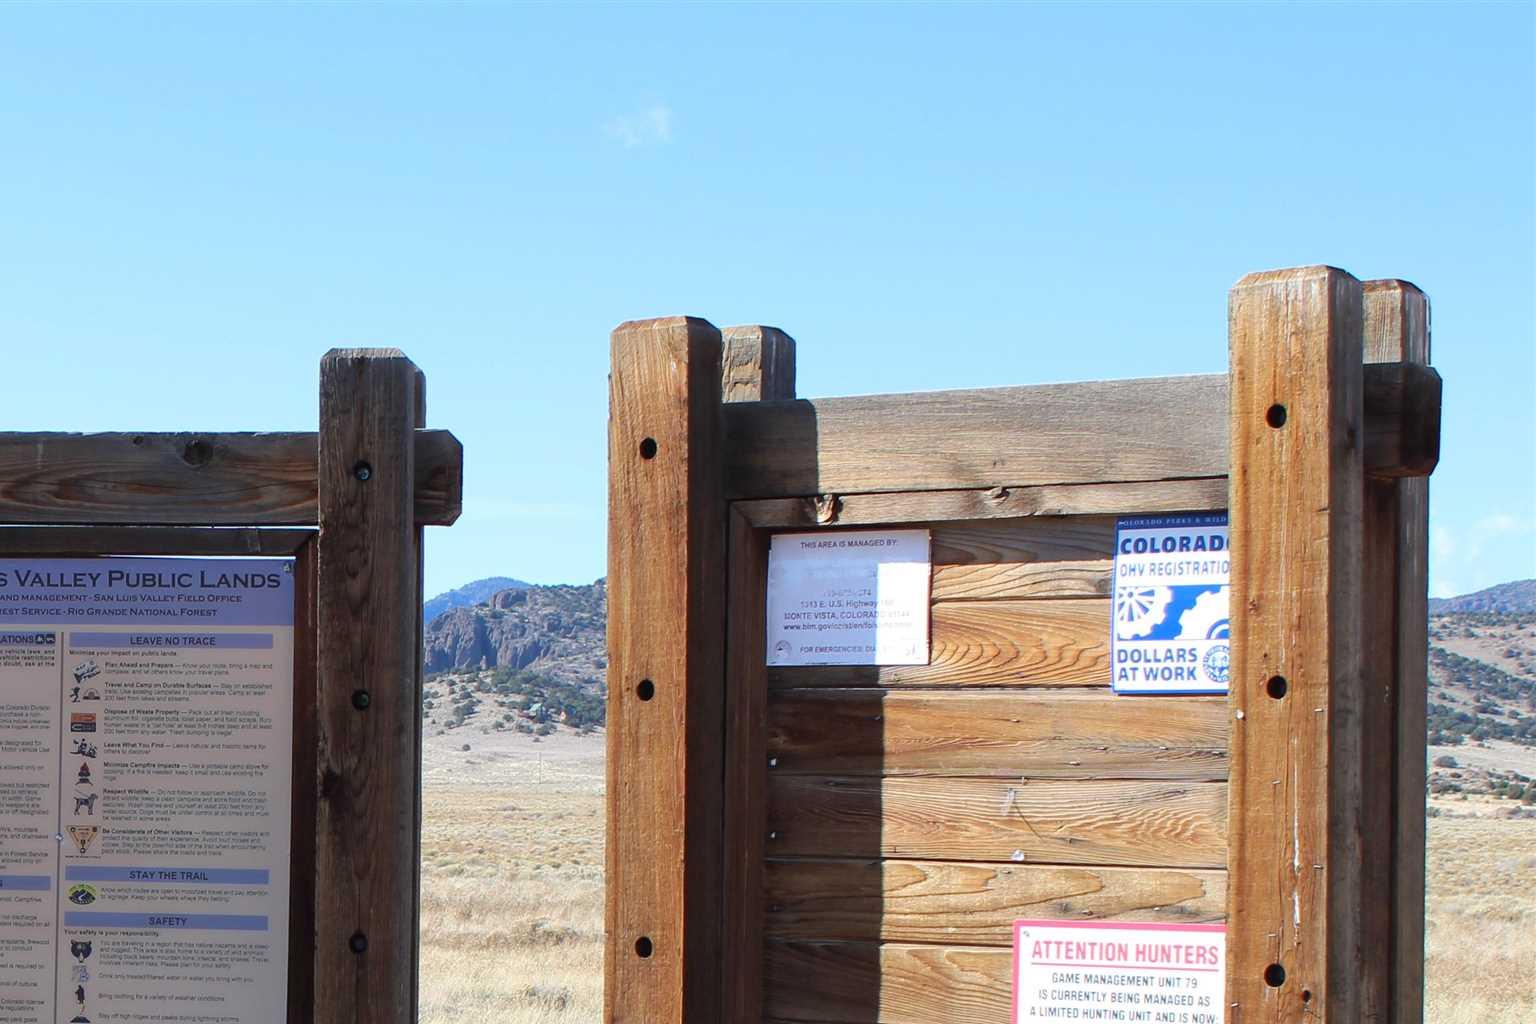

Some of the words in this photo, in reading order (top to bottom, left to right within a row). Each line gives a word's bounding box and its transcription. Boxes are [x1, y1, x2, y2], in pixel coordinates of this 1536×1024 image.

[800, 541, 816, 549] THIS
[818, 541, 838, 549] AREA
[847, 540, 885, 548] MANAGED
[1120, 535, 1230, 555] COLORAD
[1120, 563, 1145, 577] OHV
[14, 569, 102, 588] VALLEY
[107, 570, 193, 589] PUBLIC
[200, 571, 282, 589] LANDS
[21, 594, 87, 602] MANAGEMENT
[116, 594, 139, 602] LUIS
[140, 594, 175, 602] VALLEY
[177, 594, 205, 602] FIELD
[207, 594, 242, 603] OFFICE
[21, 607, 61, 616] SERVICE
[68, 608, 84, 616] RIO
[86, 608, 128, 616] GRANDE
[129, 608, 179, 616] NATIONAL
[180, 608, 217, 617] FOREST
[130, 636, 163, 646] LEAVE
[165, 637, 180, 646] NO
[182, 637, 216, 646] TRACE
[1117, 648, 1198, 664] DOLLARS
[1117, 667, 1139, 682] AT
[1143, 667, 1198, 682] WORK
[129, 871, 158, 880] STAY
[159, 872, 179, 881] THE
[181, 872, 208, 881] TRAIL
[148, 916, 188, 926] SAFETY
[1031, 940, 1128, 962] ATTENTION
[1135, 943, 1219, 965] HUNTERS
[1051, 972, 1080, 985] GAME
[1084, 973, 1155, 987] MANAGEMENT
[1158, 976, 1182, 988] UNIT
[1185, 977, 1198, 989] 79
[1038, 989, 1048, 1001] IS
[1051, 990, 1107, 1002] CURRENTLY
[1111, 992, 1140, 1004] BEING
[1143, 994, 1194, 1006] MANAGED
[1197, 996, 1210, 1007] AS
[1030, 1006, 1036, 1016] A
[1039, 1006, 1079, 1019] LIMITED
[1082, 1009, 1126, 1021] HUNTING
[1128, 1011, 1152, 1022] UNIT
[1155, 1011, 1176, 1023] AND
[1179, 1012, 1189, 1023] IS
[1192, 1013, 1219, 1024] NOW:
